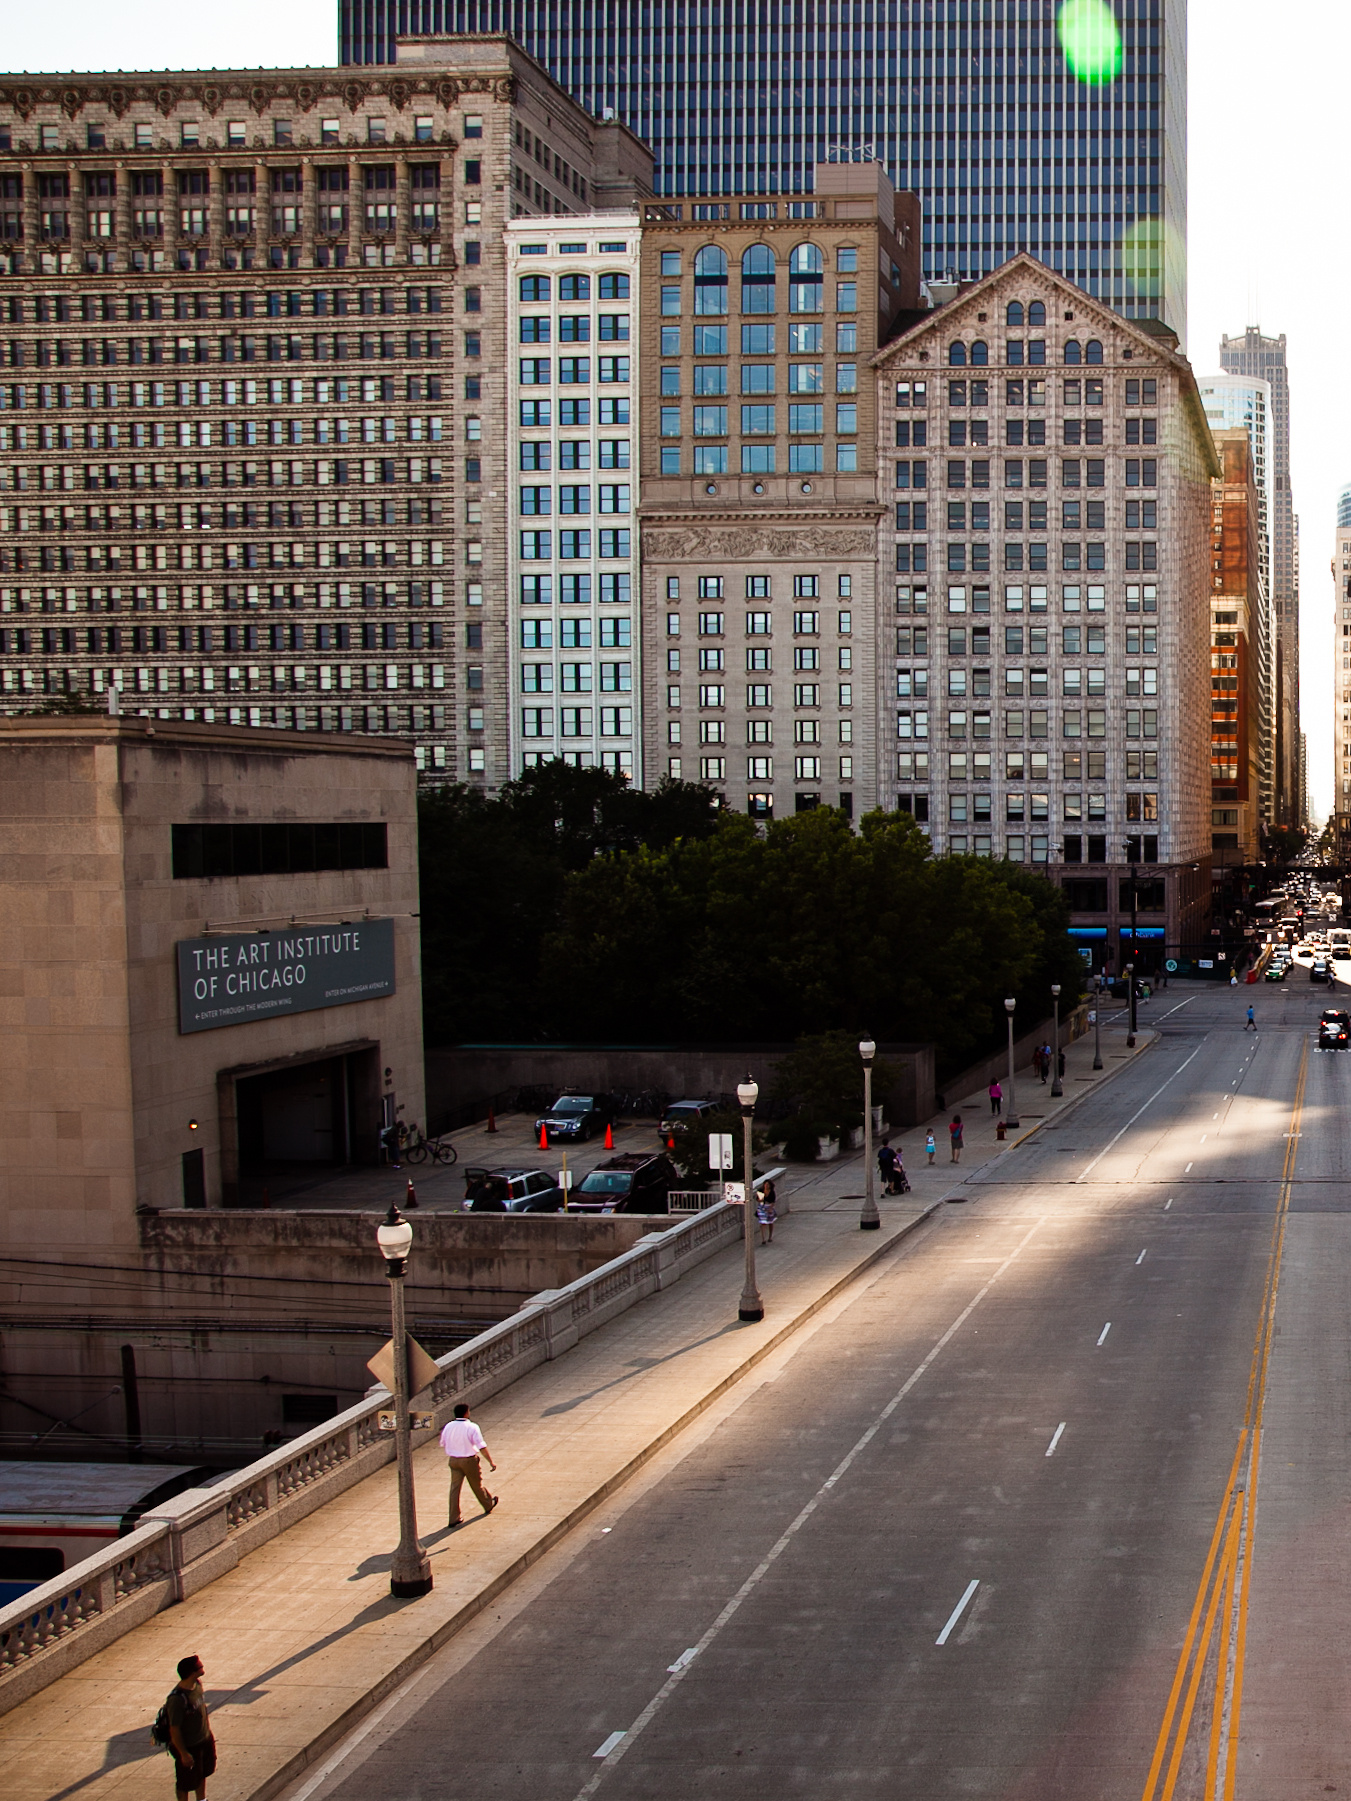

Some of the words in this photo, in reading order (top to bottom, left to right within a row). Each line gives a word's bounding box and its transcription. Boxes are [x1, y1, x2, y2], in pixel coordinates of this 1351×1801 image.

[192, 946, 230, 971] THE
[236, 941, 271, 966] ART
[277, 932, 361, 961] INSTITUTE
[194, 976, 218, 1000] OF
[226, 964, 306, 995] CHICAGO
[325, 988, 340, 998] ENTER
[340, 986, 347, 995] ON
[347, 983, 369, 994] MICHIGAN
[368, 980, 385, 990] AVENUE
[200, 1009, 219, 1020] ENTER
[219, 1005, 246, 1017] THROUGH
[246, 1003, 257, 1013] THE
[256, 999, 278, 1010] MODERN
[278, 997, 292, 1007] WING
